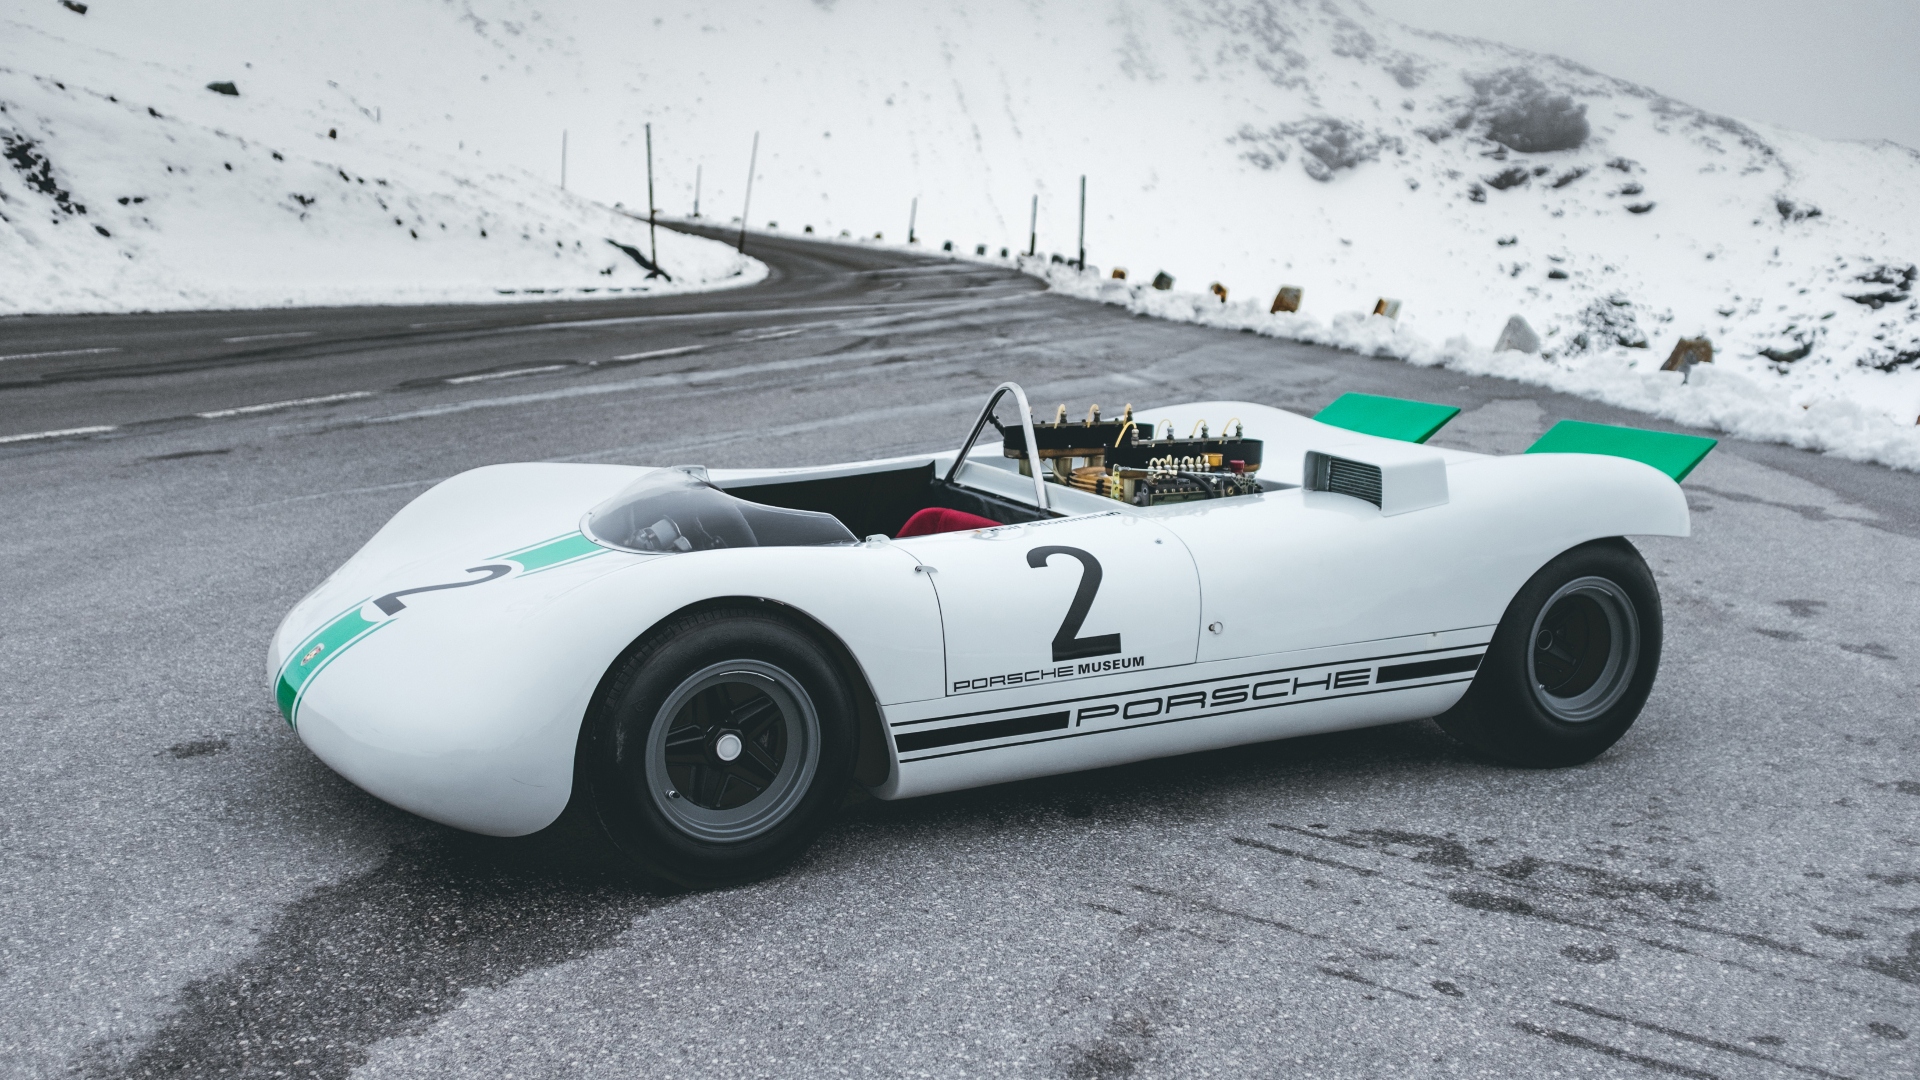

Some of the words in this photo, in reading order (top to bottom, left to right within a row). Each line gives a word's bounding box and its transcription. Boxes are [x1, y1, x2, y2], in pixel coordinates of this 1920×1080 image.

[373, 564, 512, 616] 2
[1026, 545, 1121, 662] 2
[954, 665, 1074, 692] PORSCHE
[1078, 656, 1145, 675] MUSEUM
[1076, 668, 1371, 728] PORSCHE
